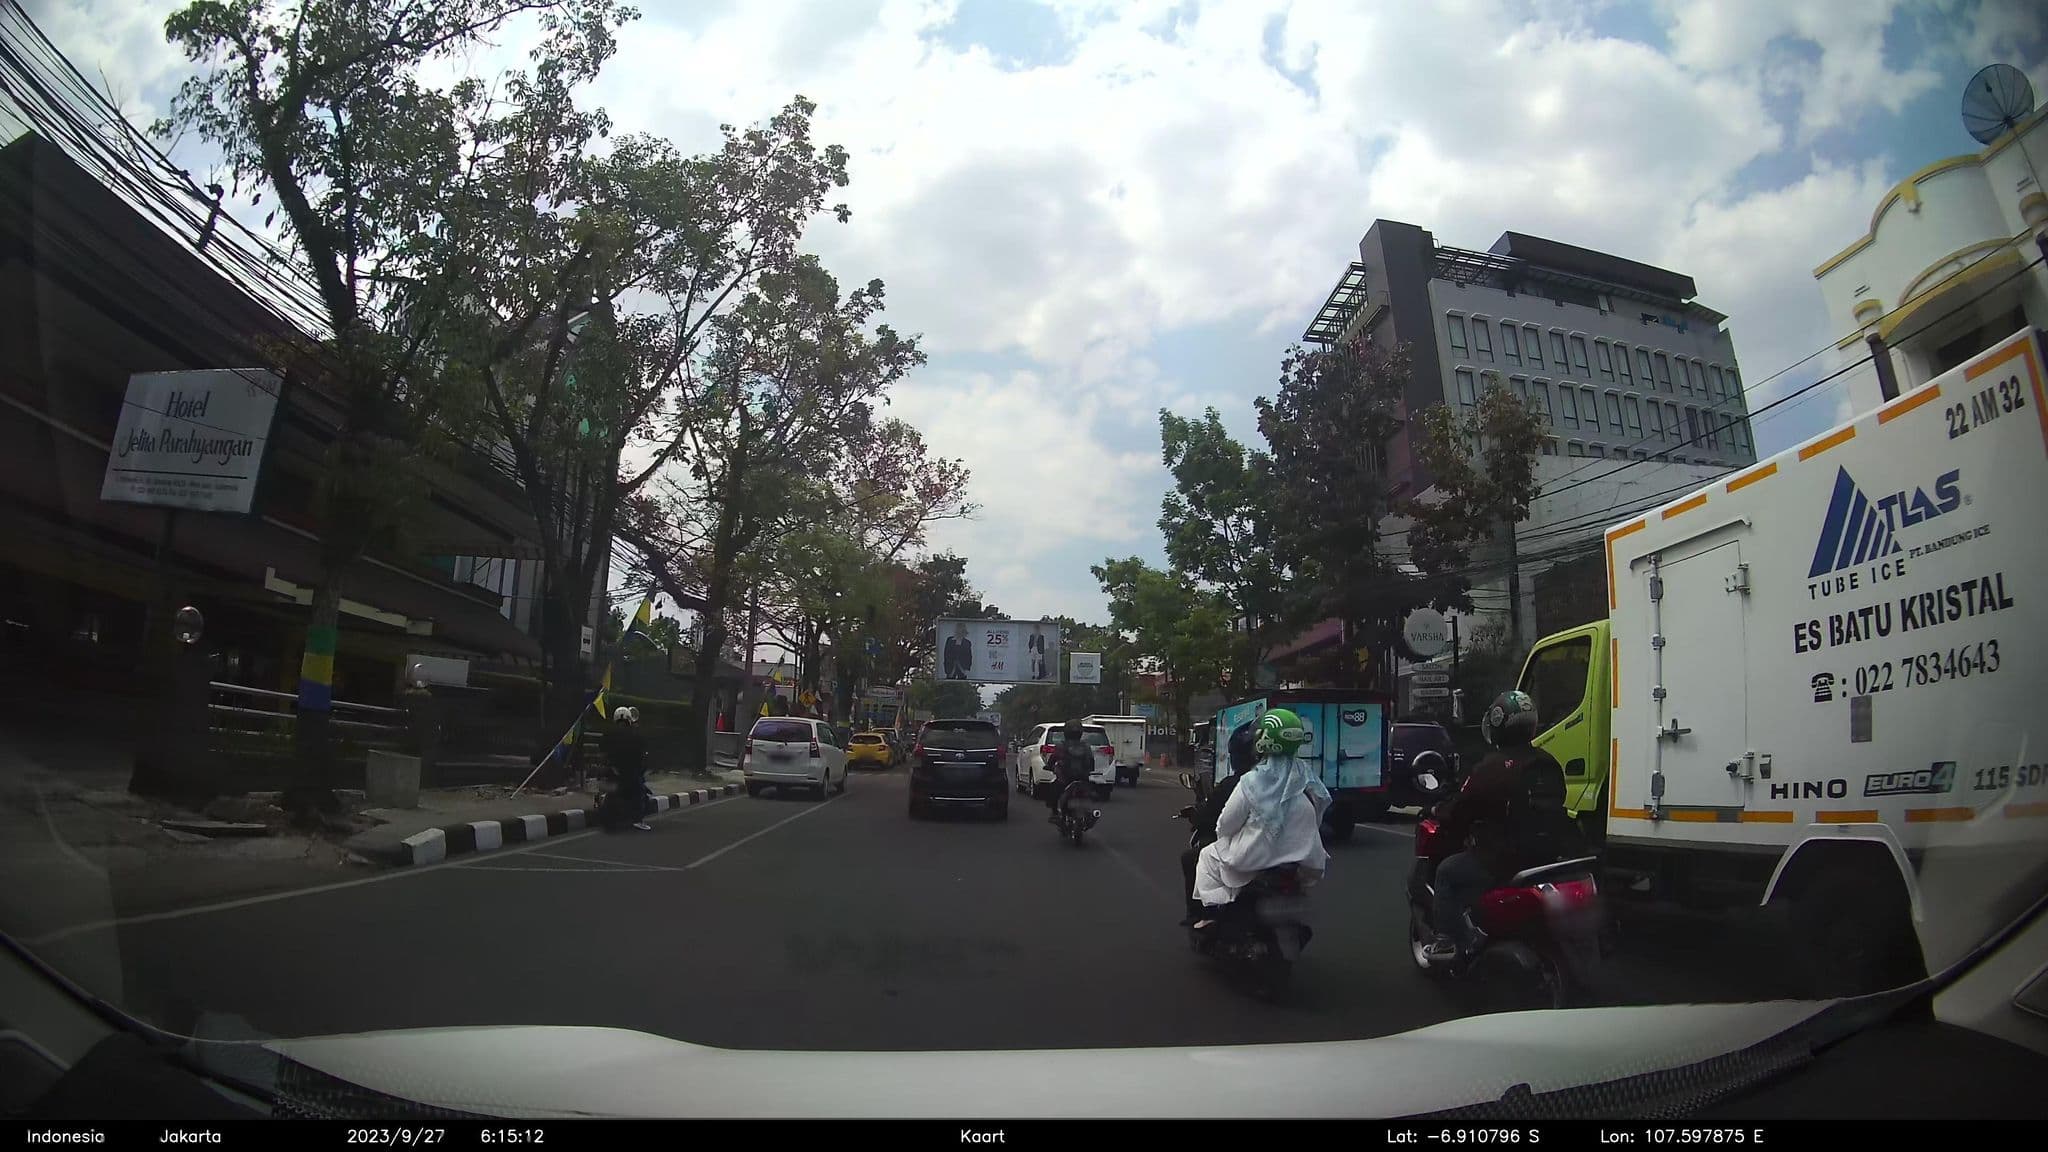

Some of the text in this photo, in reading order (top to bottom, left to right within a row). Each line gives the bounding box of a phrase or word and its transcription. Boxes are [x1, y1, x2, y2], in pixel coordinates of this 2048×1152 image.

[165, 390, 210, 418] Hotel
[1945, 375, 2025, 440] 22 AM 32
[119, 428, 253, 466] Jelita Parahyangan
[1973, 524, 1991, 538] ICE
[1808, 558, 1906, 601] TUBE ICE
[1793, 571, 2014, 654] ES BATU KRISTAL
[1411, 632, 1445, 641] VARSHA
[1855, 661, 1894, 696] 022
[1901, 639, 2001, 688] 7834643
[1770, 778, 1848, 800] HINO
[1973, 765, 2010, 791] 115
